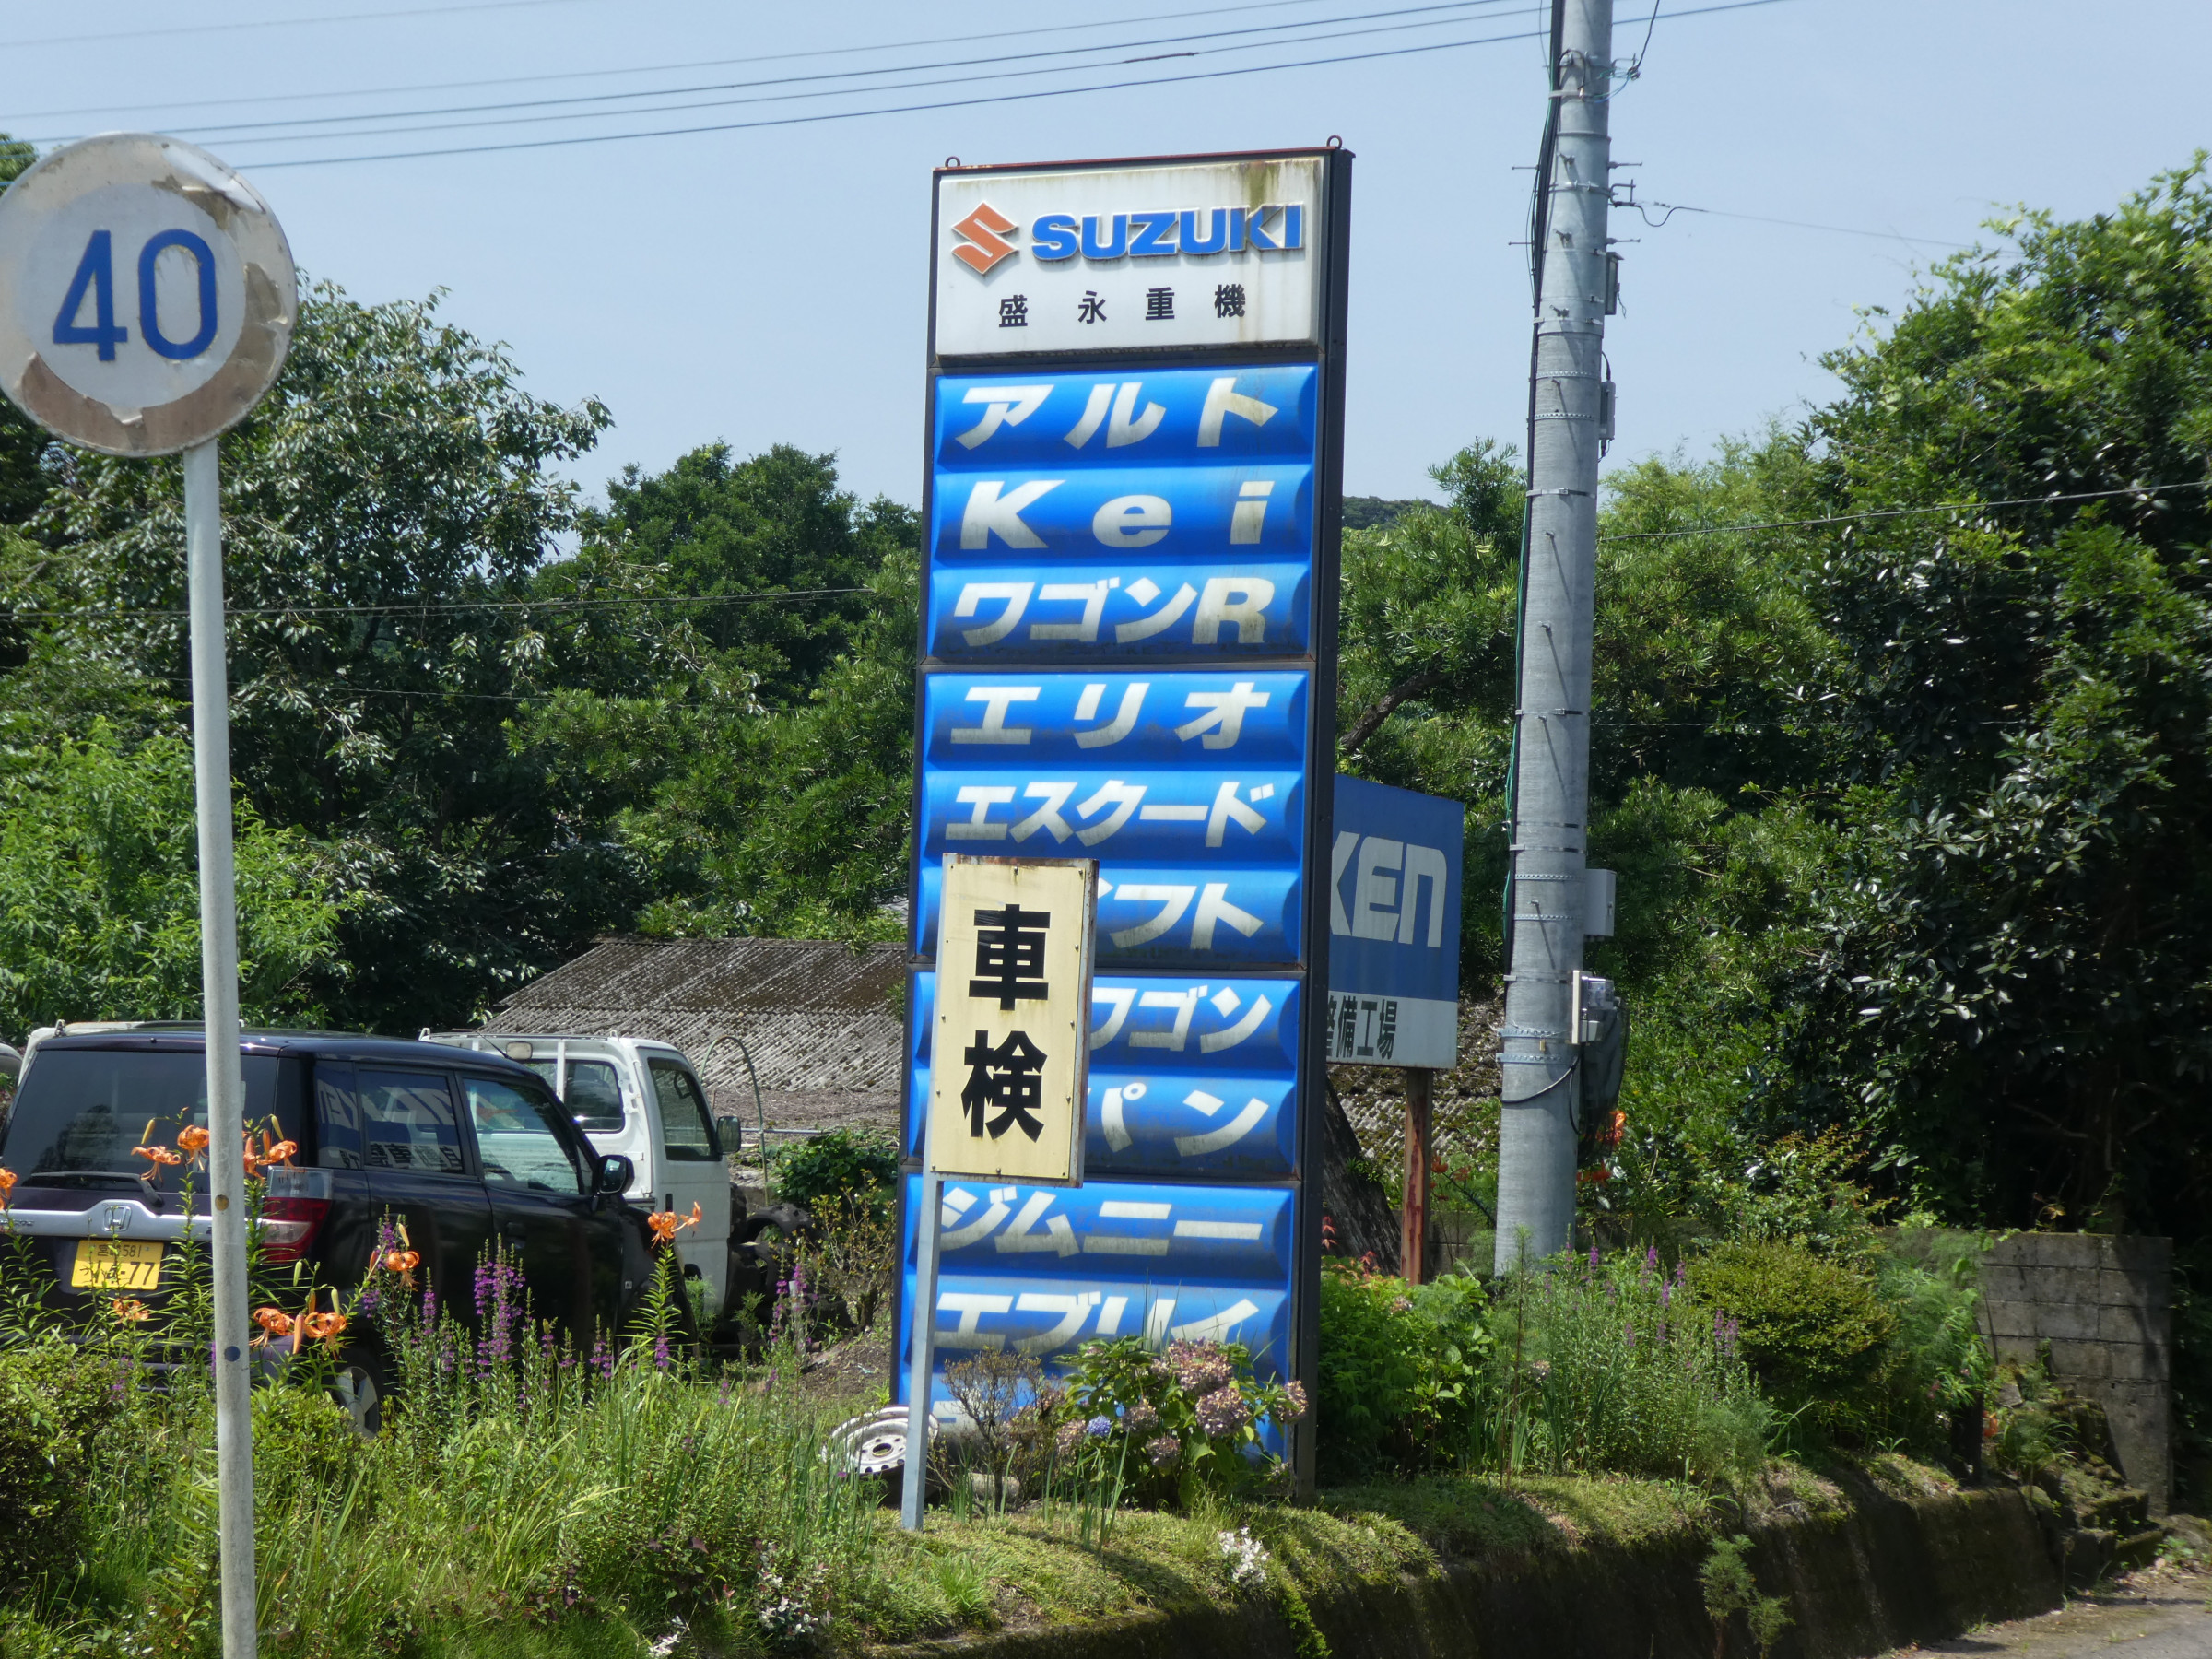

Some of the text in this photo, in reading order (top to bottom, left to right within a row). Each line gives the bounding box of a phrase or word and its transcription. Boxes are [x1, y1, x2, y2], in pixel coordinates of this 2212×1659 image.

[1030, 202, 1304, 262] SUZUKI
[53, 228, 218, 361] 40
[998, 284, 1246, 328] 盛永重機
[954, 377, 1279, 451] アルト
[959, 479, 1276, 550] Kei
[953, 577, 1277, 647] ワゴンR
[950, 682, 1271, 750] エリオ
[945, 780, 1275, 848] エスクード
[1098, 877, 1265, 950] フト
[960, 903, 1052, 1144] 車検
[1088, 1082, 1269, 1157] パン
[939, 1185, 1263, 1259] ジムニー
